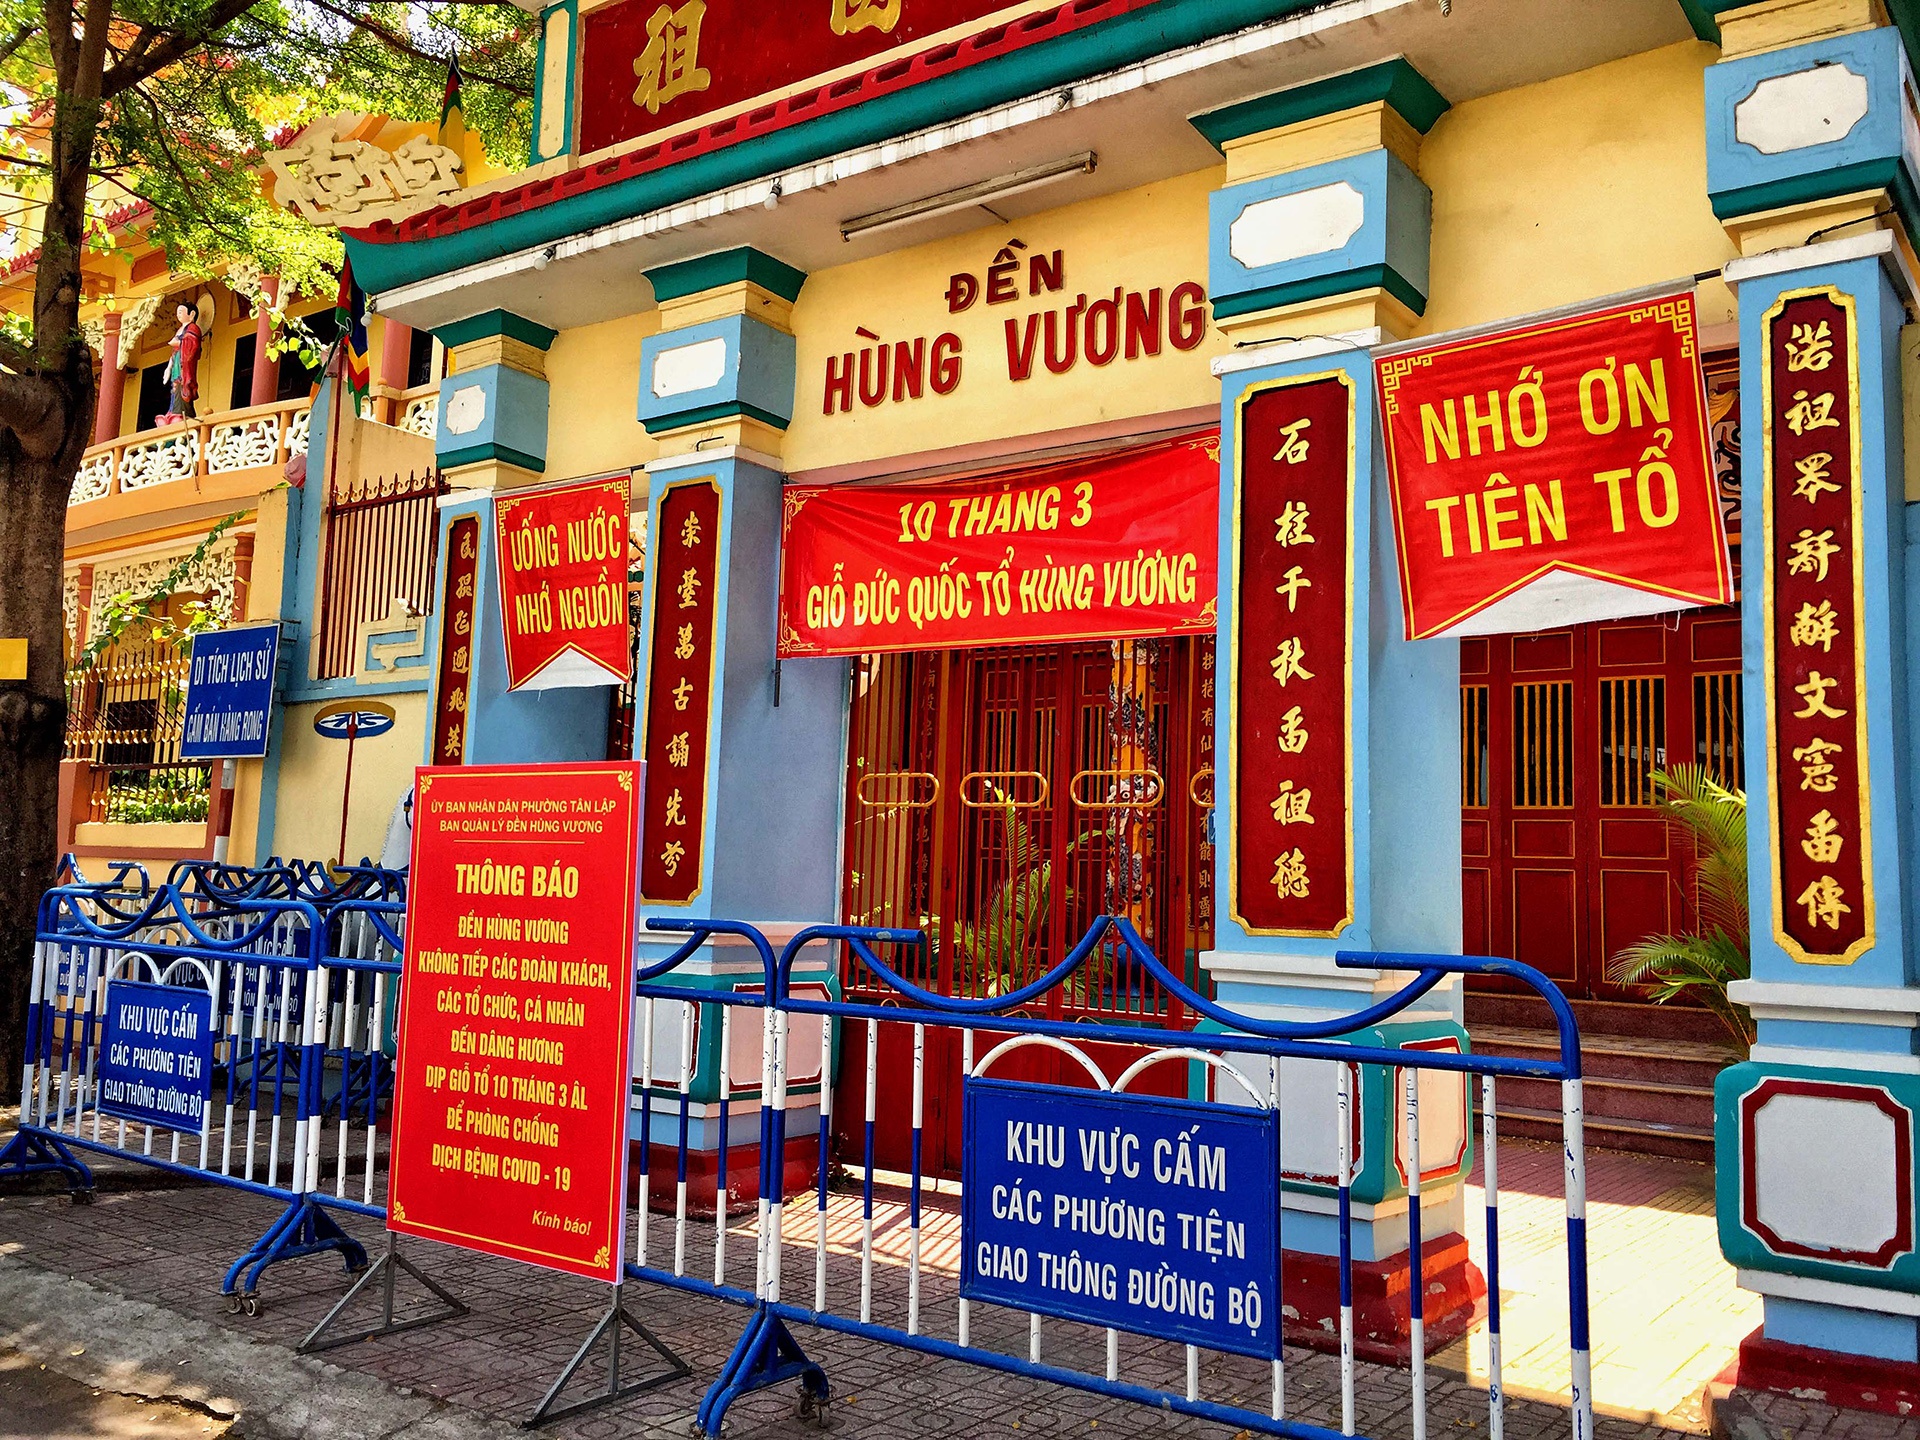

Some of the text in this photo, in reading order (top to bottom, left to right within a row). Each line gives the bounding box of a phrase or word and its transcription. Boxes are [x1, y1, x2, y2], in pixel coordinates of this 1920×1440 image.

[944, 238, 1064, 314] ĐỀN
[823, 281, 1206, 415] HÙNG VƯƠNG
[1419, 356, 1671, 464] NHỚ ƠN
[898, 501, 936, 542] 10
[1070, 481, 1093, 527] 3
[1425, 428, 1680, 558] TIÊN TỔ
[511, 506, 621, 572] UỐNG NƯỚC
[515, 566, 623, 635] NHỚ NGUỒN
[807, 545, 1196, 630] GIỖ ĐỨC QUỐC TỔ HÙNG VƯƠNG
[194, 638, 271, 687] DI TÍCH LỊCH SỬ
[187, 703, 263, 742] CẤM BÁN HÀNG RONG
[431, 798, 616, 815] ỦY BAN NHÂN DÂN PHƯỜNG TÂN LẬP
[440, 815, 602, 832] BAN QUẢN LÝ ĐỀN HÙNG VƯƠNG
[455, 859, 579, 898] THÔNG BÁO
[458, 910, 569, 944] ĐỀN HÙNG VƯƠNG
[418, 948, 611, 991] KHÔNG TIẾP CÁC ĐOÀN KHÁCH,
[119, 1004, 143, 1032] KHU
[147, 1006, 169, 1039] VỰC
[171, 1003, 198, 1040] CẤM
[437, 985, 584, 1026] CÁC TỔ CHỨC, CÁ NHÂN
[110, 1041, 201, 1081] CÁC PHƯƠNG TIỆN
[451, 1024, 563, 1065] ĐẾN DÂNG HƯƠNG
[104, 1079, 202, 1122] GIAO THÔNG ĐƯỜNG BỘ
[426, 1062, 588, 1110] DỊP GIỖ TỔ 10 THÁNG 3 ÂL
[447, 1100, 559, 1147] ĐỂ PHÒNG CHỐNG
[432, 1143, 461, 1172] DỊCH
[464, 1147, 499, 1179] BỆNH
[502, 1156, 540, 1186] COVID
[554, 1166, 571, 1192] 19
[1007, 1120, 1226, 1192] KHU VỰC CẤM
[532, 1210, 592, 1235] Kính báo!
[992, 1178, 1245, 1262] CÁC PHƯƠNG TIỆN
[977, 1241, 1262, 1336] GIAO THÔNG ĐƯỜNG BỘ
